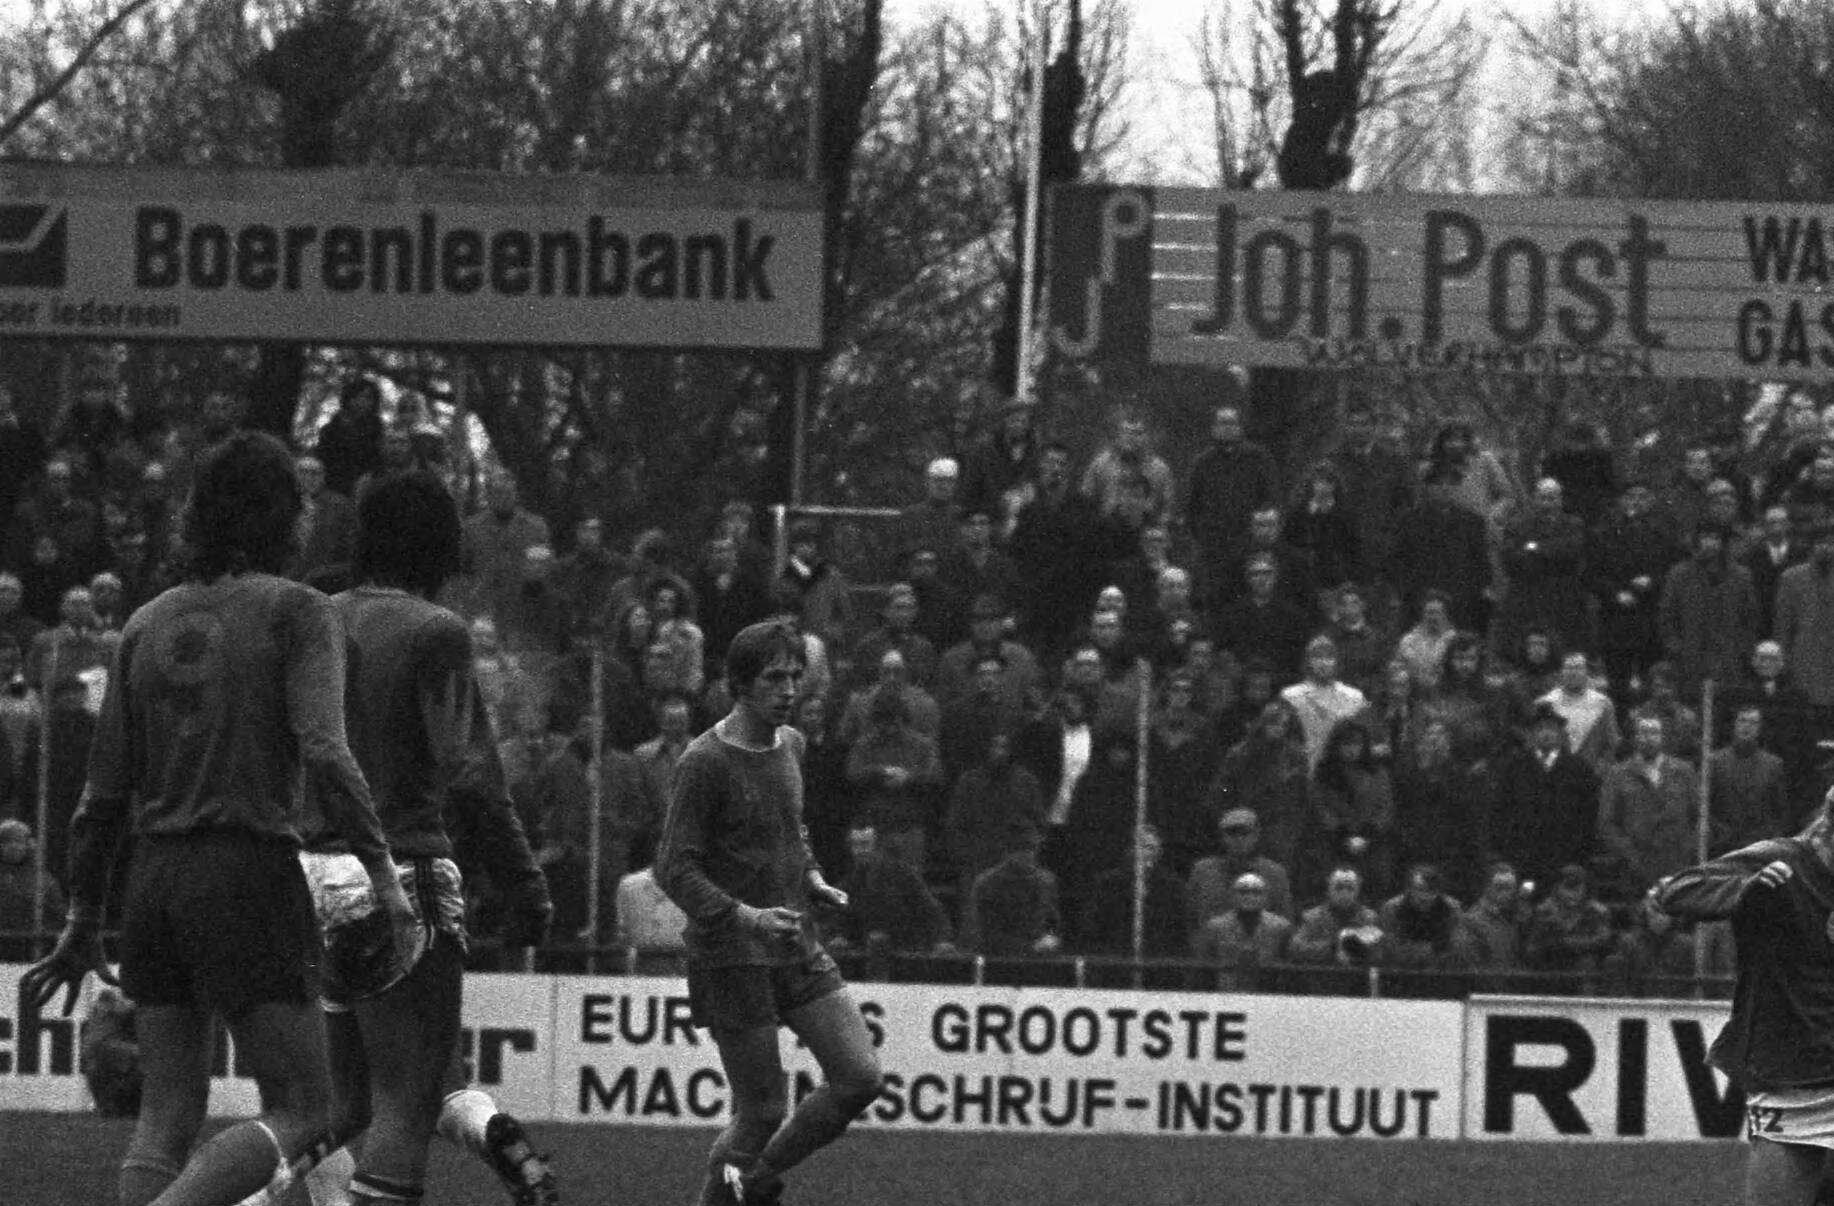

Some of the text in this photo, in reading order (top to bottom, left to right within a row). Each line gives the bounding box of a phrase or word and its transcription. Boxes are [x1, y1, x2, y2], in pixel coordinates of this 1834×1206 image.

[135, 204, 777, 303] Boerenleenbank
[1190, 203, 1668, 348] Joh. Post
[931, 1003, 1248, 1061] GROOTSTE
